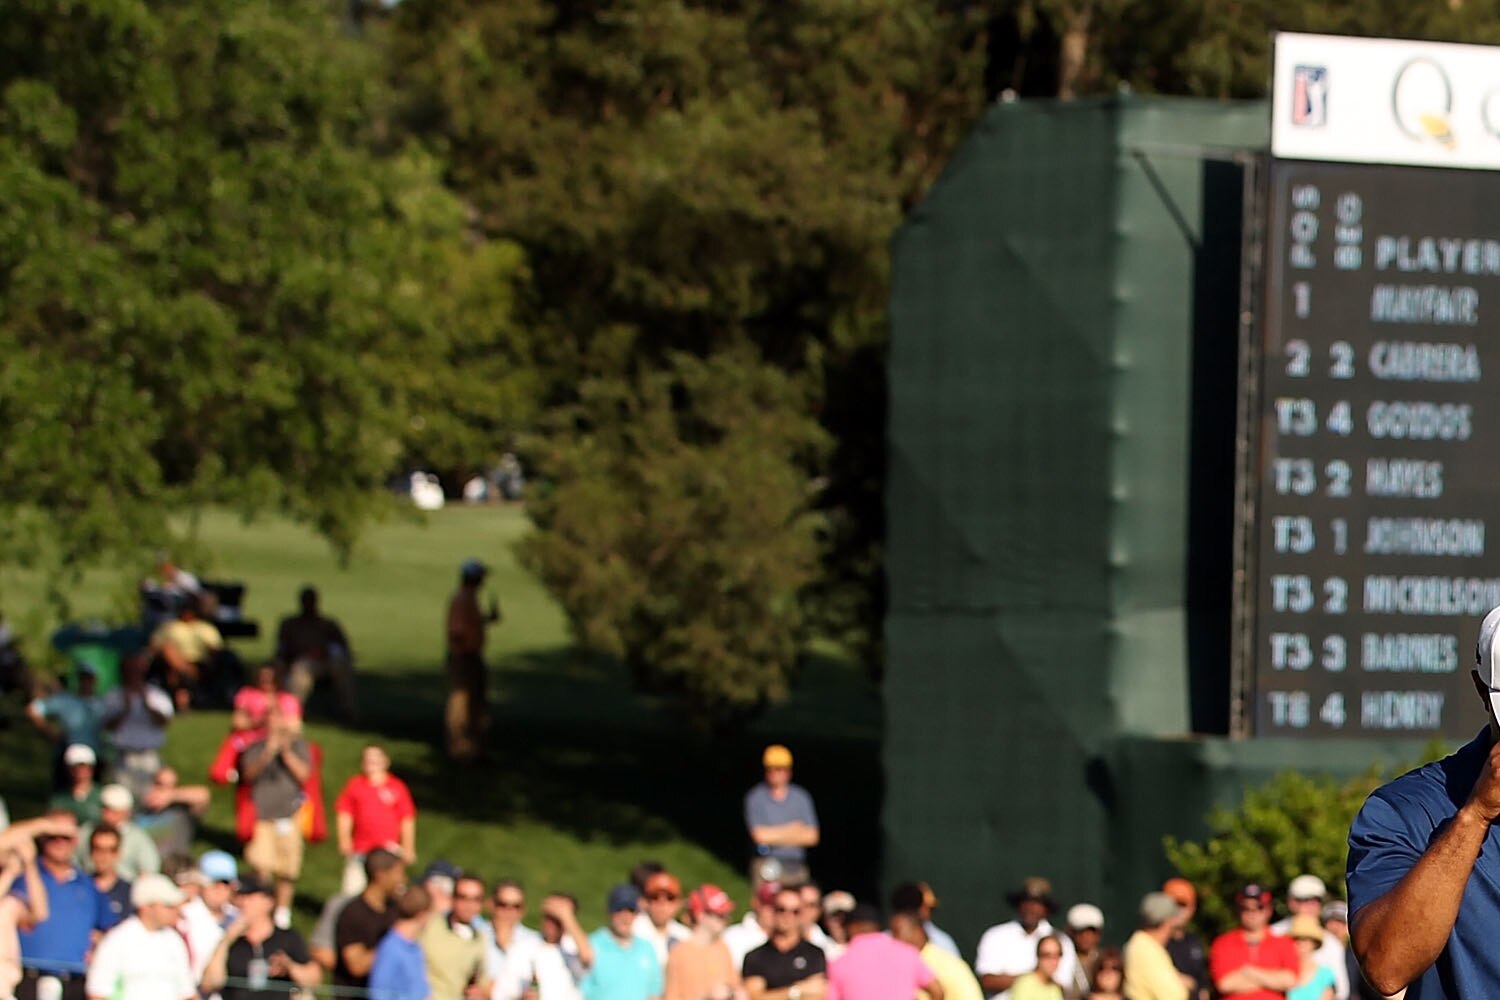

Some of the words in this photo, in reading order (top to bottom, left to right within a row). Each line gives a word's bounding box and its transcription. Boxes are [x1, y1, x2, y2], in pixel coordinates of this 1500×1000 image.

[1294, 282, 1310, 317] 1
[1286, 340, 1311, 377] 2
[1329, 341, 1355, 378] 2
[1274, 398, 1317, 435] T3
[1326, 401, 1352, 434] 4
[1273, 458, 1317, 495] T3
[1324, 459, 1350, 497] 2
[1274, 516, 1315, 553] T3
[1331, 518, 1348, 555] 1
[1272, 575, 1314, 613] T3
[1323, 577, 1348, 613] 2
[1271, 633, 1313, 670] T3
[1322, 635, 1347, 671] 3
[1319, 693, 1345, 726] 4
